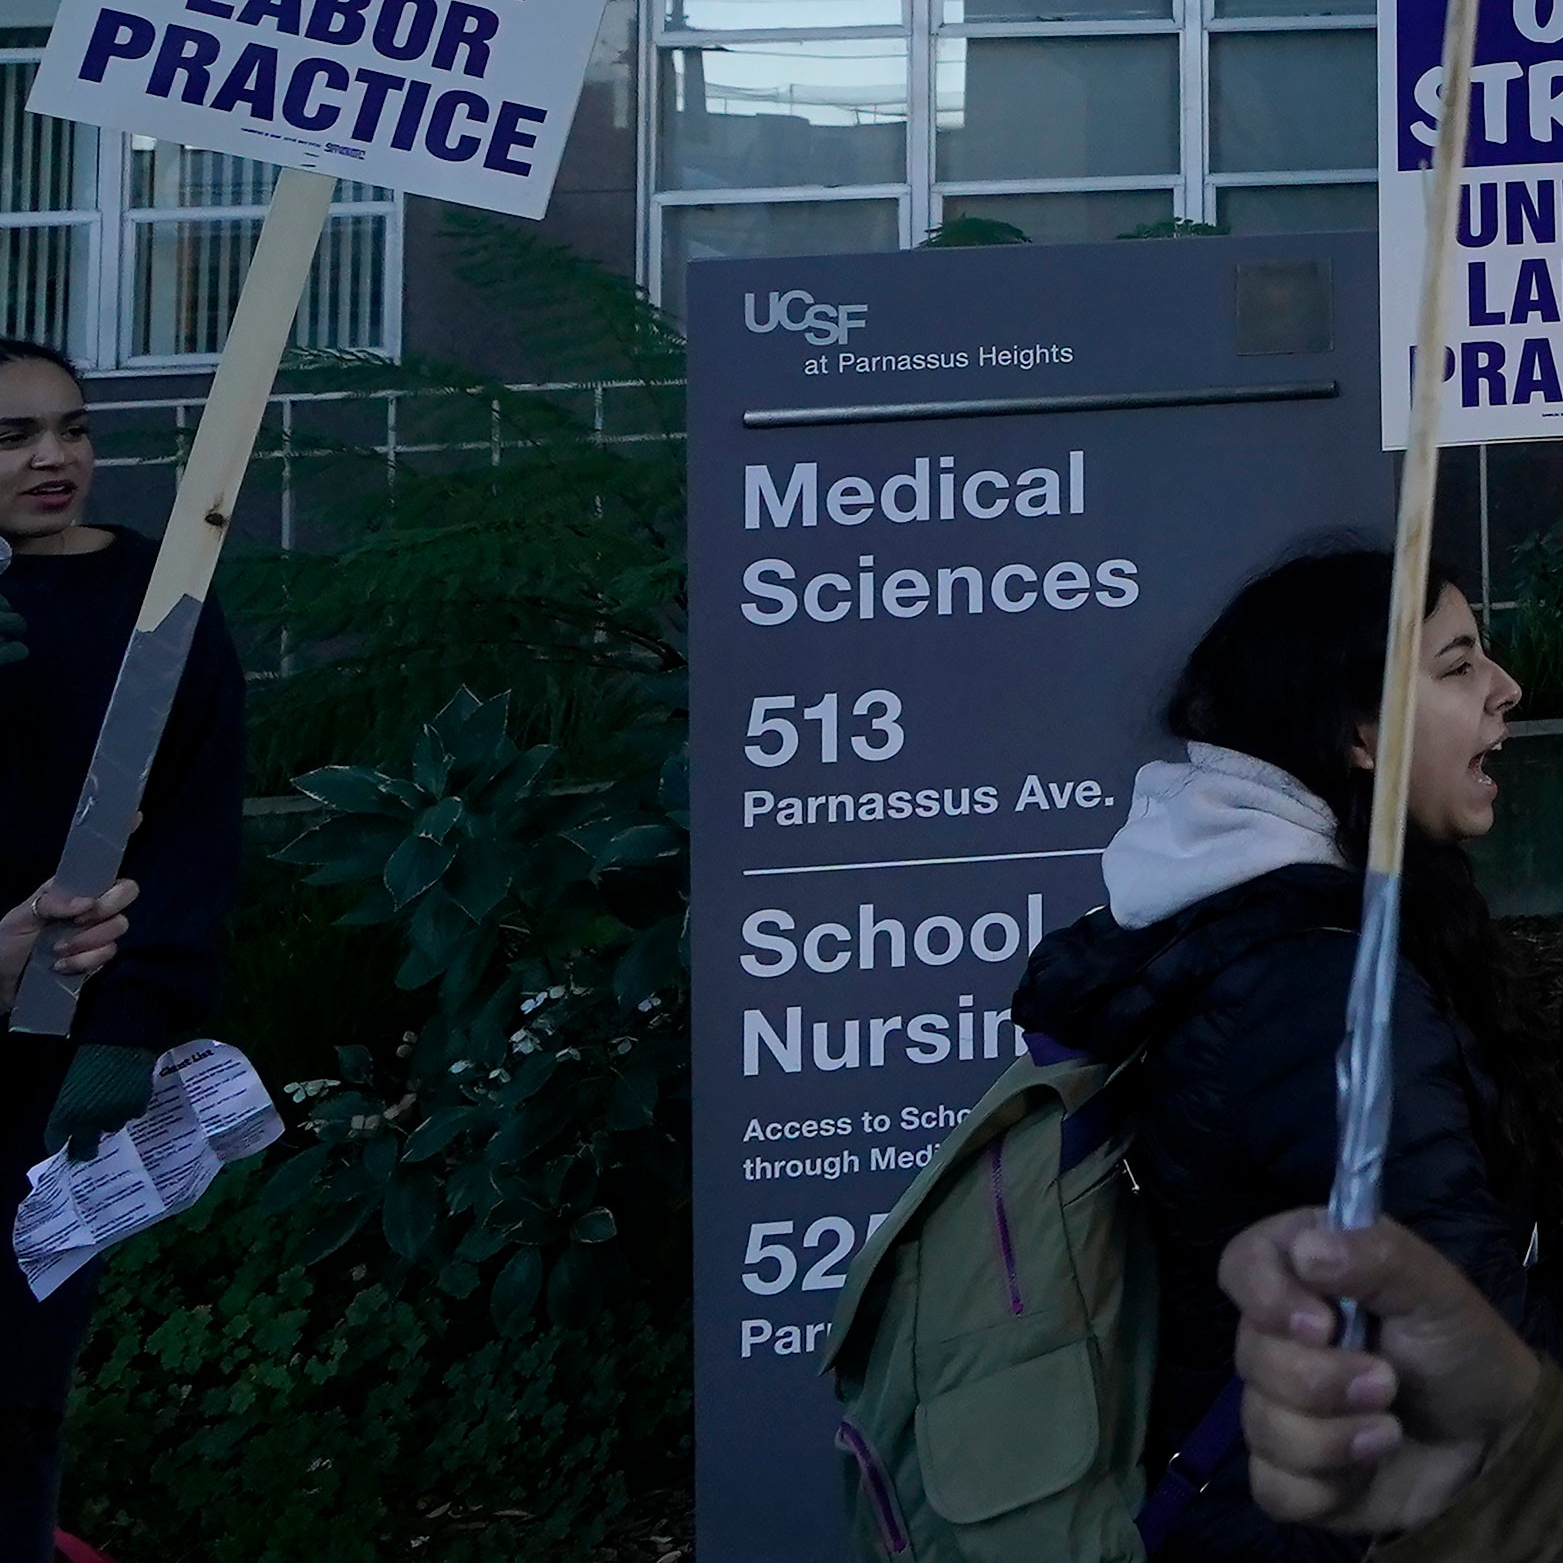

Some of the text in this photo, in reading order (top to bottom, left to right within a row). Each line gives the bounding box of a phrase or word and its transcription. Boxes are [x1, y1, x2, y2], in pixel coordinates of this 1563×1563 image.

[78, 8, 548, 177] PRACTICE
[744, 289, 868, 346] UCSF
[803, 342, 1074, 375] at Parnassus Heights
[743, 450, 1086, 530] Medical
[741, 554, 1140, 627] Sciences
[744, 688, 905, 769] 513
[744, 774, 1115, 828] Parnassus Ave.
[740, 892, 1044, 978] School
[743, 1117, 852, 1142] Access
[861, 1111, 891, 1134] to
[743, 1149, 860, 1181] through
[741, 1317, 833, 1359] Par
